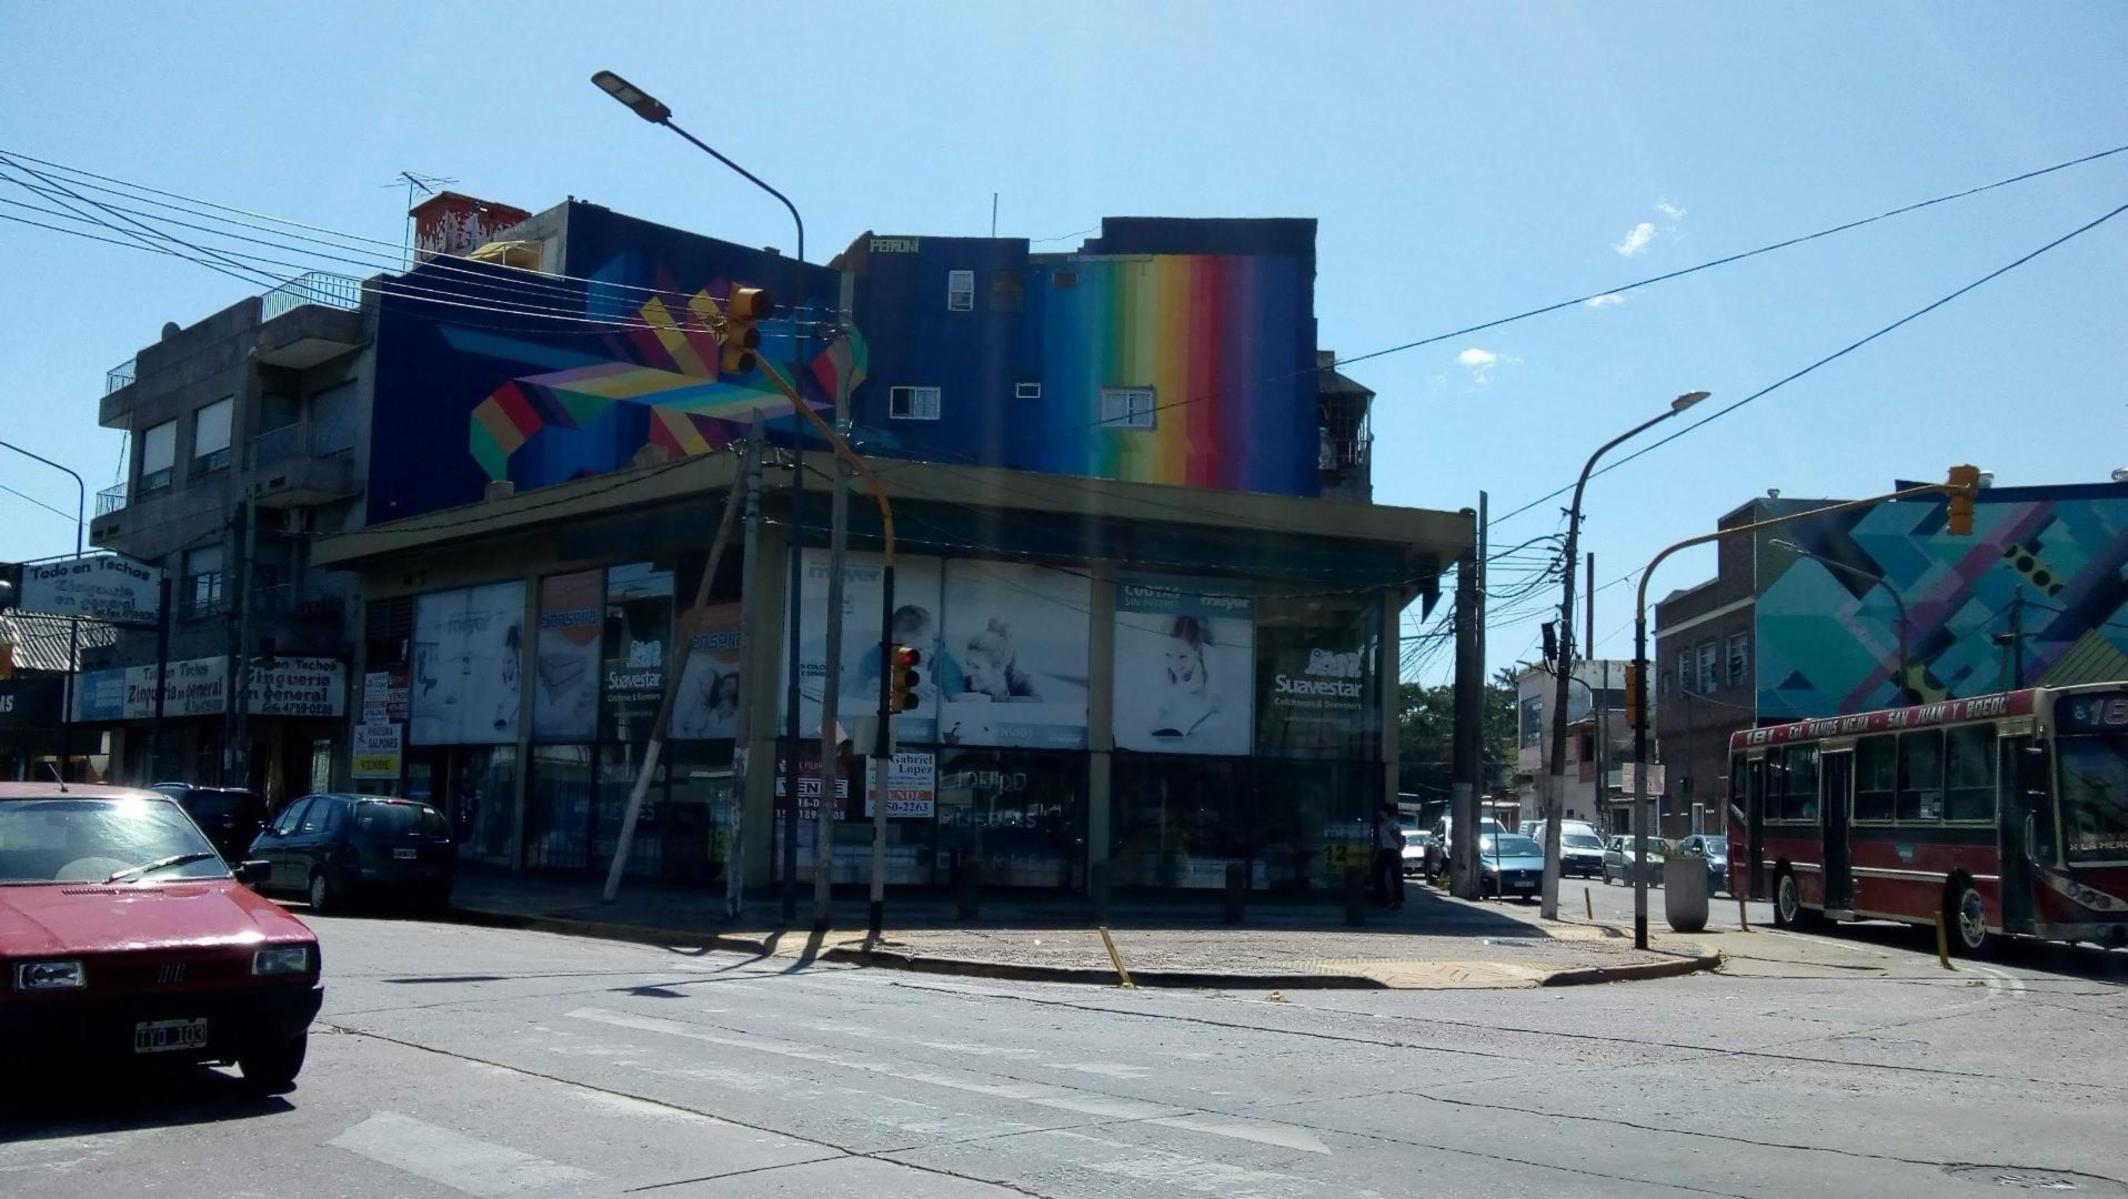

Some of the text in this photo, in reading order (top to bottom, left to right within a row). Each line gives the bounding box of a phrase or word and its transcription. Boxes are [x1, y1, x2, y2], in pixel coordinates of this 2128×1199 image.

[30, 556, 151, 580] Todo en Techos
[606, 671, 662, 690] Suavestar
[1274, 674, 1363, 697] Suavestar
[1746, 729, 1775, 745] 181
[1807, 719, 1839, 737] RAMOS
[1887, 711, 1910, 729] SAN
[1914, 705, 1946, 725] JUAN
[1952, 702, 1961, 720] Y
[894, 754, 932, 765] Gabriel
[899, 764, 932, 776] Lopez
[176, 1024, 206, 1045] 103
